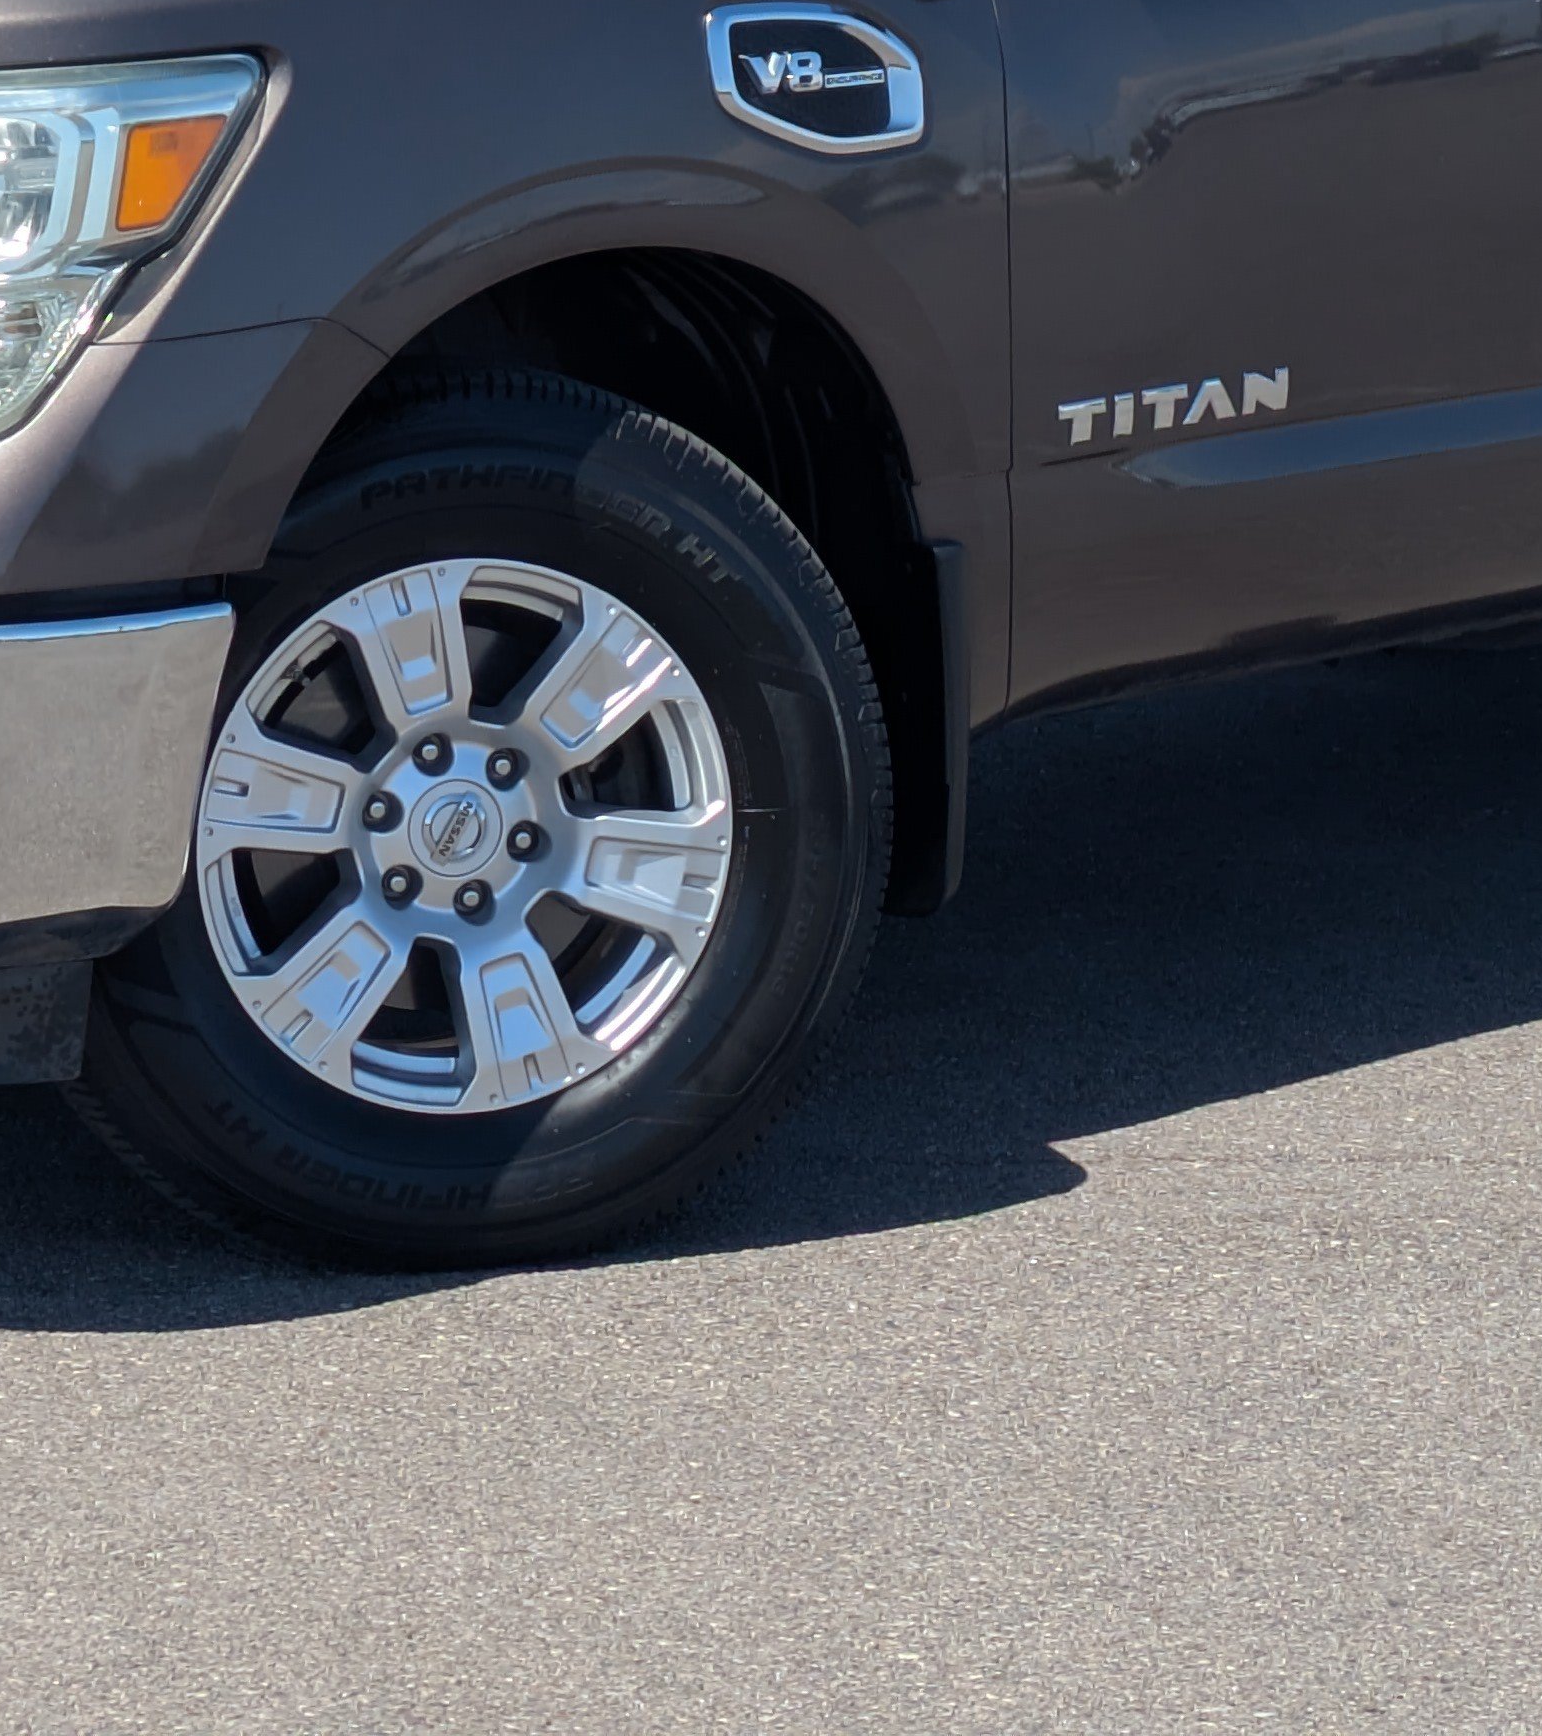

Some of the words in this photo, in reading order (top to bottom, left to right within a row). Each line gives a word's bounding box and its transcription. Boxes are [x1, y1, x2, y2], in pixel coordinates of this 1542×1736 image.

[738, 51, 823, 95] V8
[1057, 366, 1289, 447] TITAN
[438, 800, 475, 857] NISSAN
